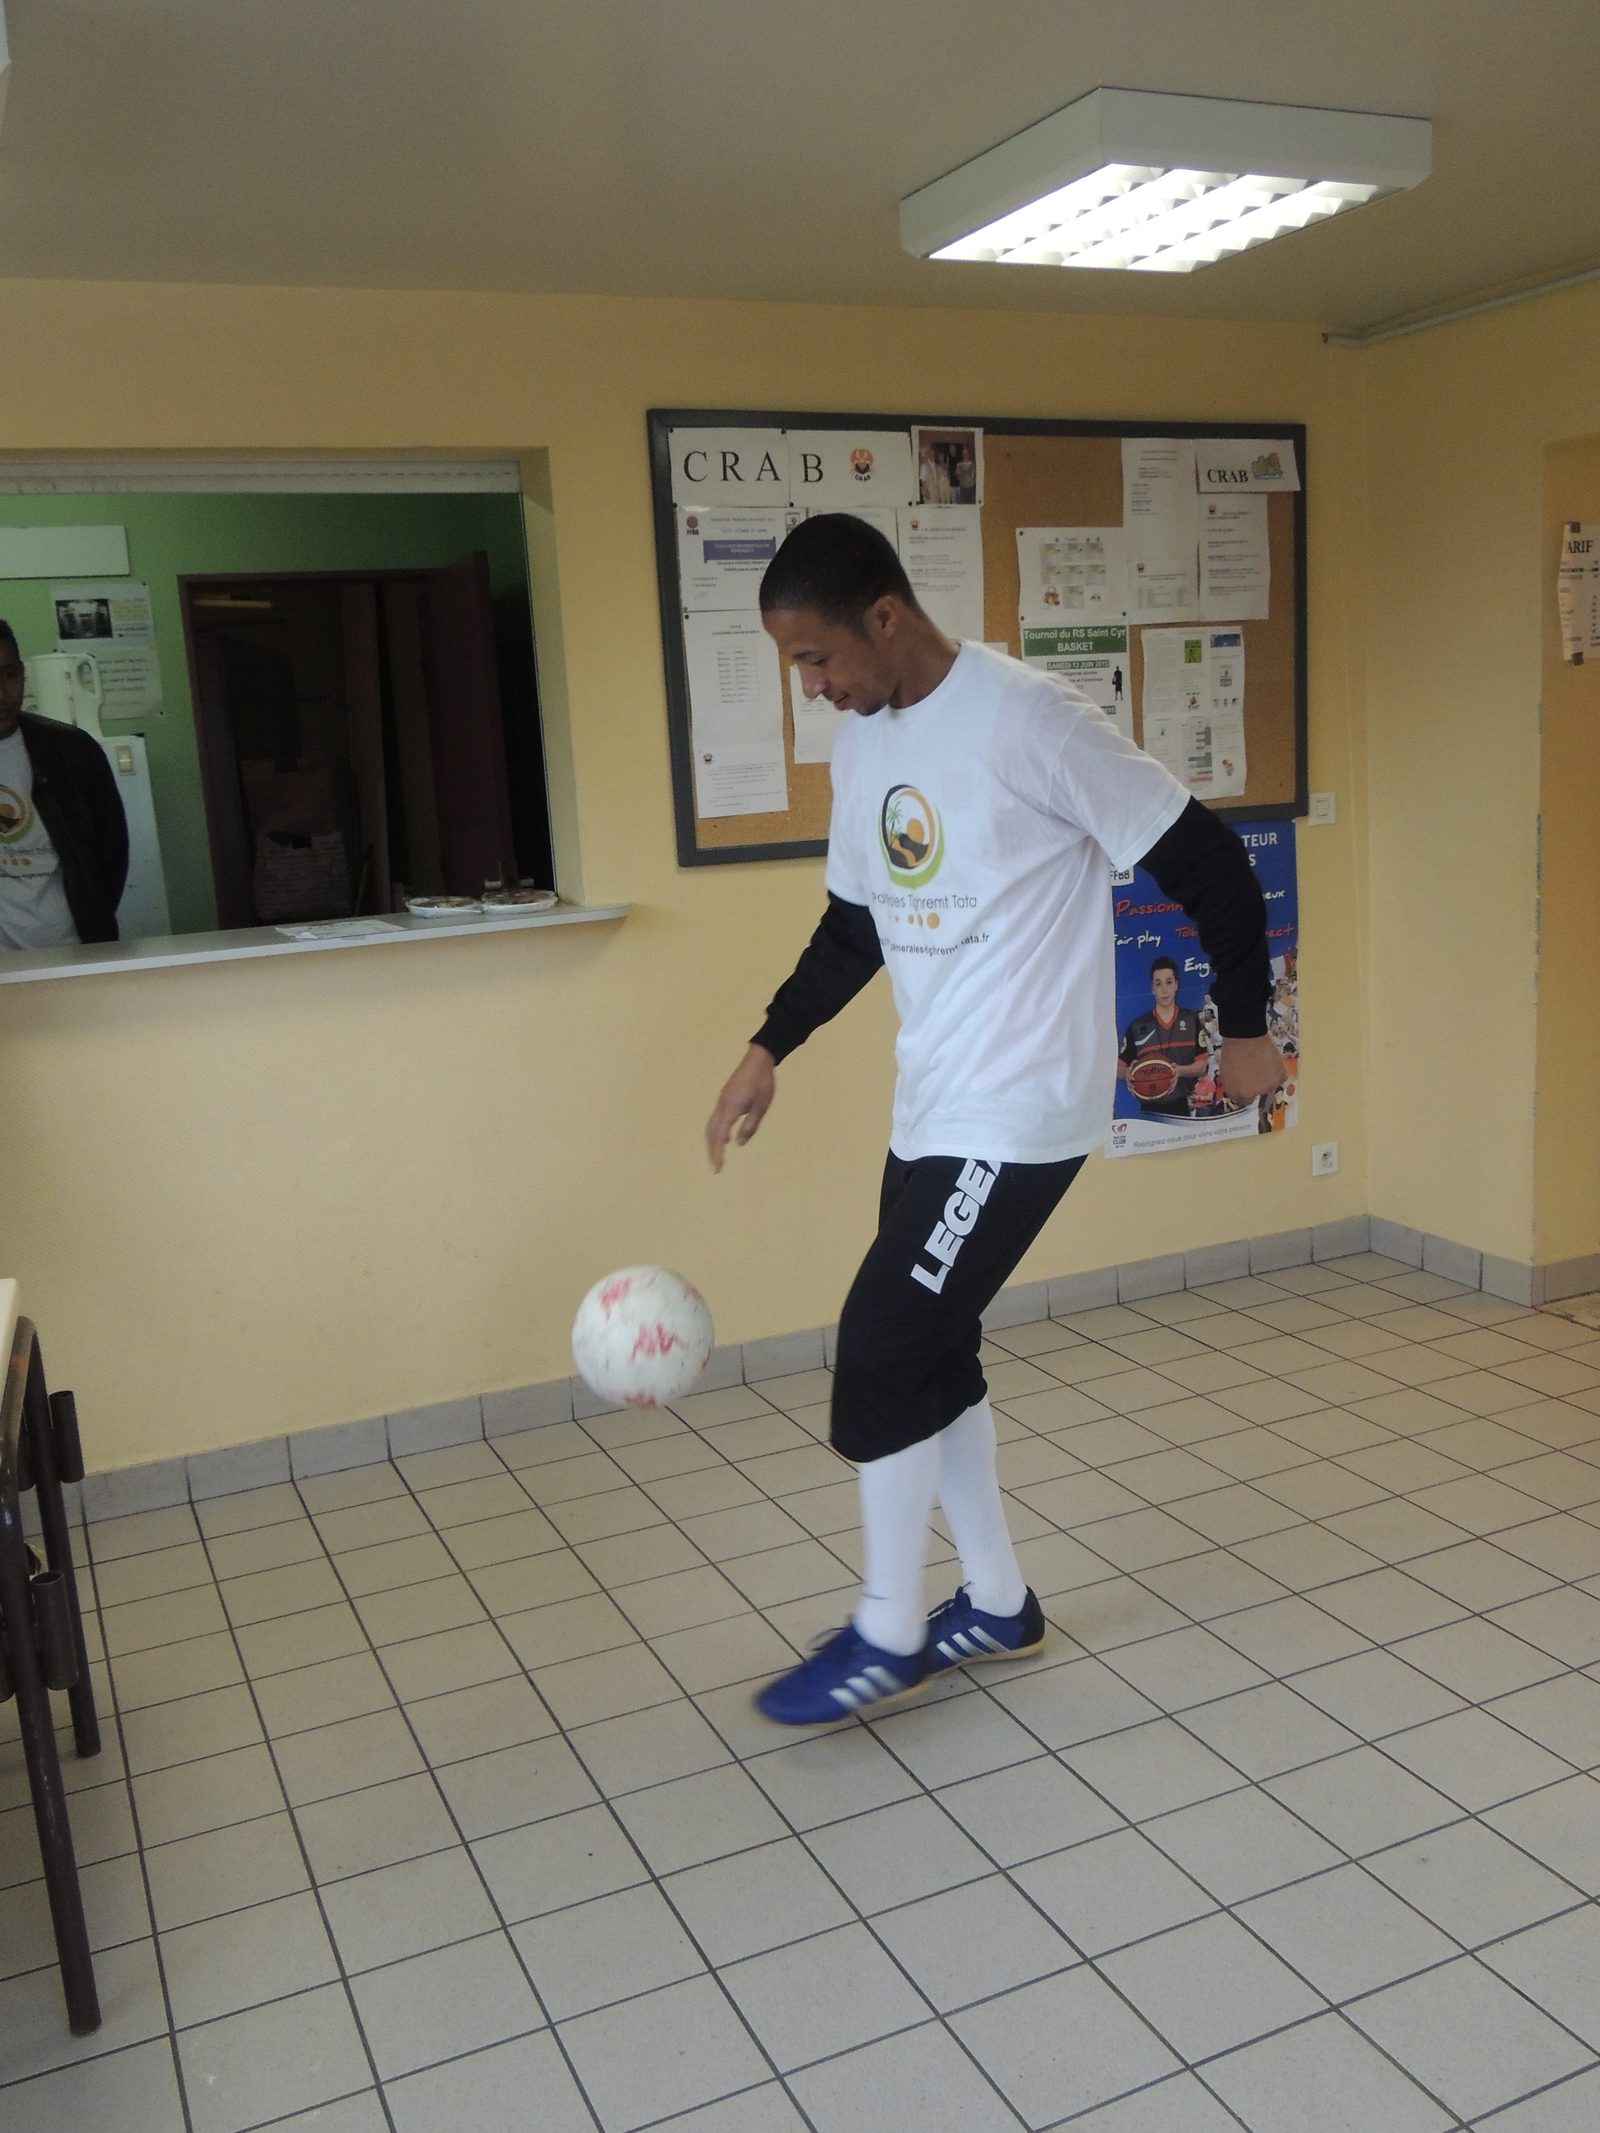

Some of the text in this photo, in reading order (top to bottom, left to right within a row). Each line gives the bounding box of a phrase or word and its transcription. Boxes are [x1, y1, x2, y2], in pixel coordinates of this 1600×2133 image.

[1207, 469, 1248, 483] CRAB
[1567, 540, 1594, 553] ARIF
[1024, 627, 1125, 640] Tournoi du RS Saint Cyr
[1057, 642, 1094, 652] BASKET
[1241, 832, 1278, 848] TEUR
[951, 894, 977, 908] Tata
[1116, 898, 1184, 917] Passionn
[1137, 930, 1161, 949] play
[1184, 957, 1211, 978] Eng
[1112, 1138, 1126, 1146] CLUB
[910, 1158, 1002, 1295] LEGE
